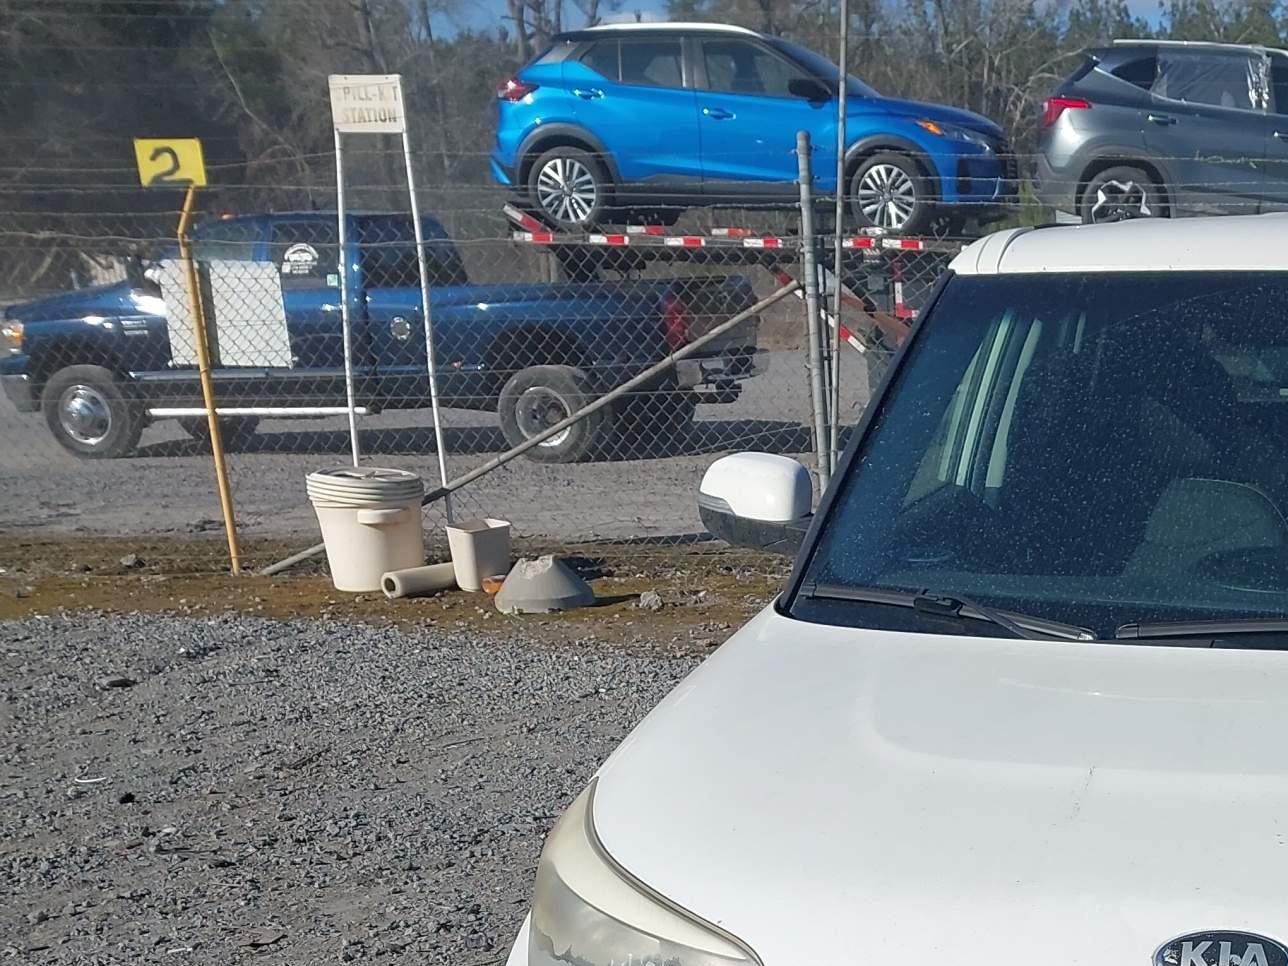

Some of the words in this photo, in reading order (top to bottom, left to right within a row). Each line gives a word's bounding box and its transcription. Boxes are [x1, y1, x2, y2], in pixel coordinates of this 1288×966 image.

[336, 85, 398, 102] PILL-KT
[343, 106, 398, 123] STATION
[149, 146, 194, 188] 2
